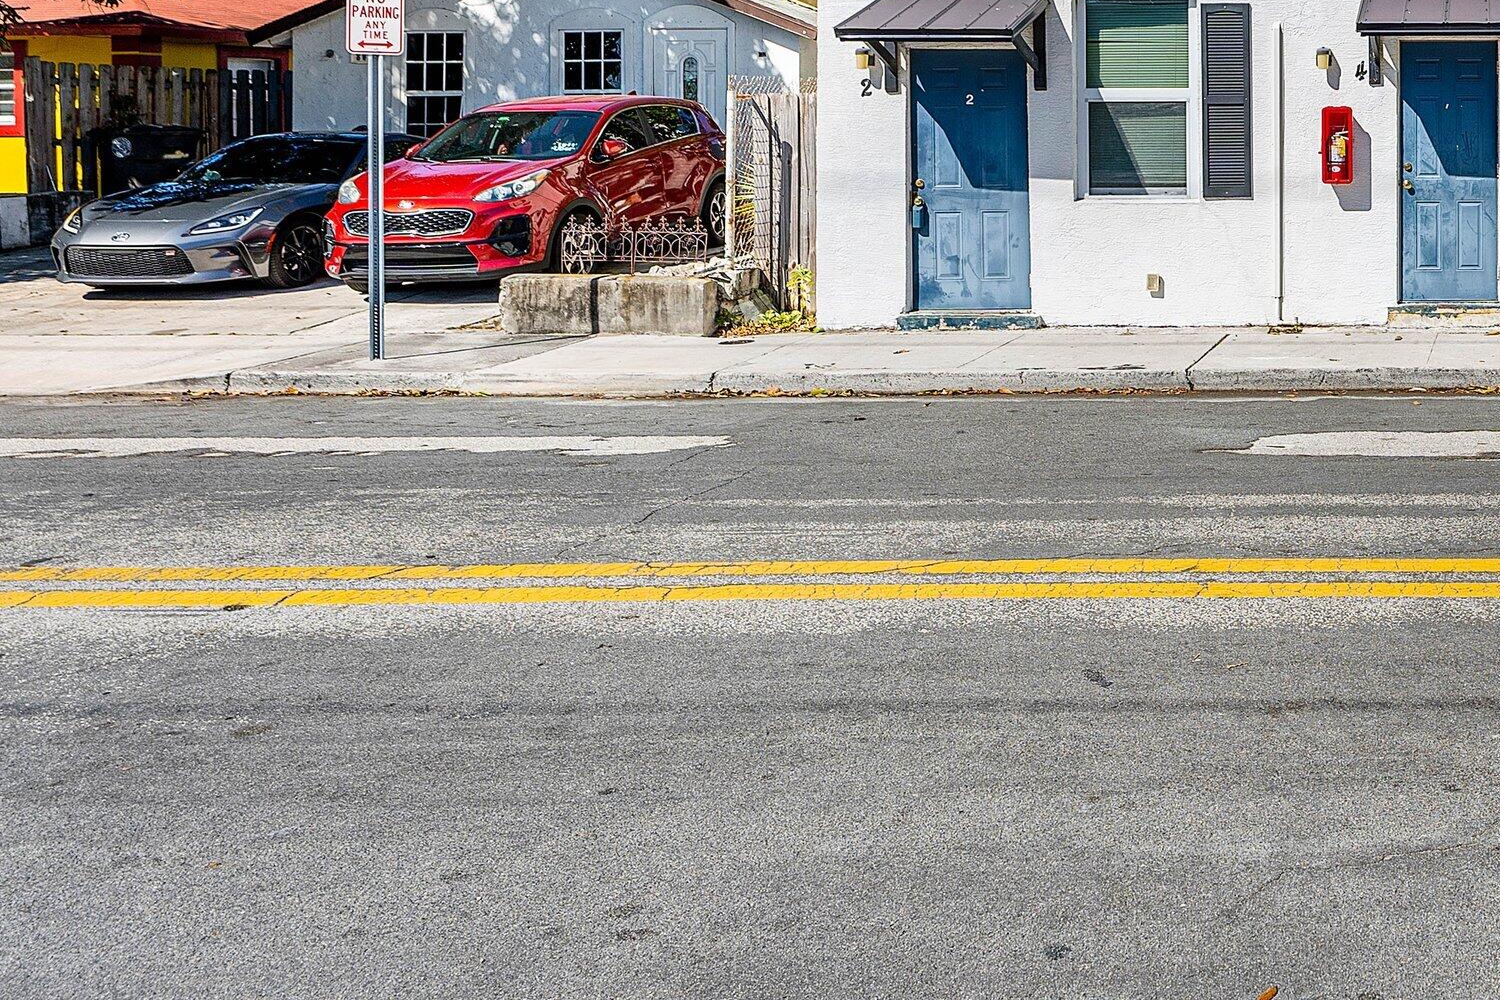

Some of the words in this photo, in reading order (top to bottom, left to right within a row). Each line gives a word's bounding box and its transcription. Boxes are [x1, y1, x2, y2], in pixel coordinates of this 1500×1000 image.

[352, 5, 399, 19] PARKING
[365, 20, 387, 30] ANY
[363, 30, 389, 39] TIME
[1355, 60, 1368, 80] 4
[860, 78, 872, 97] 2
[965, 94, 974, 105] 2
